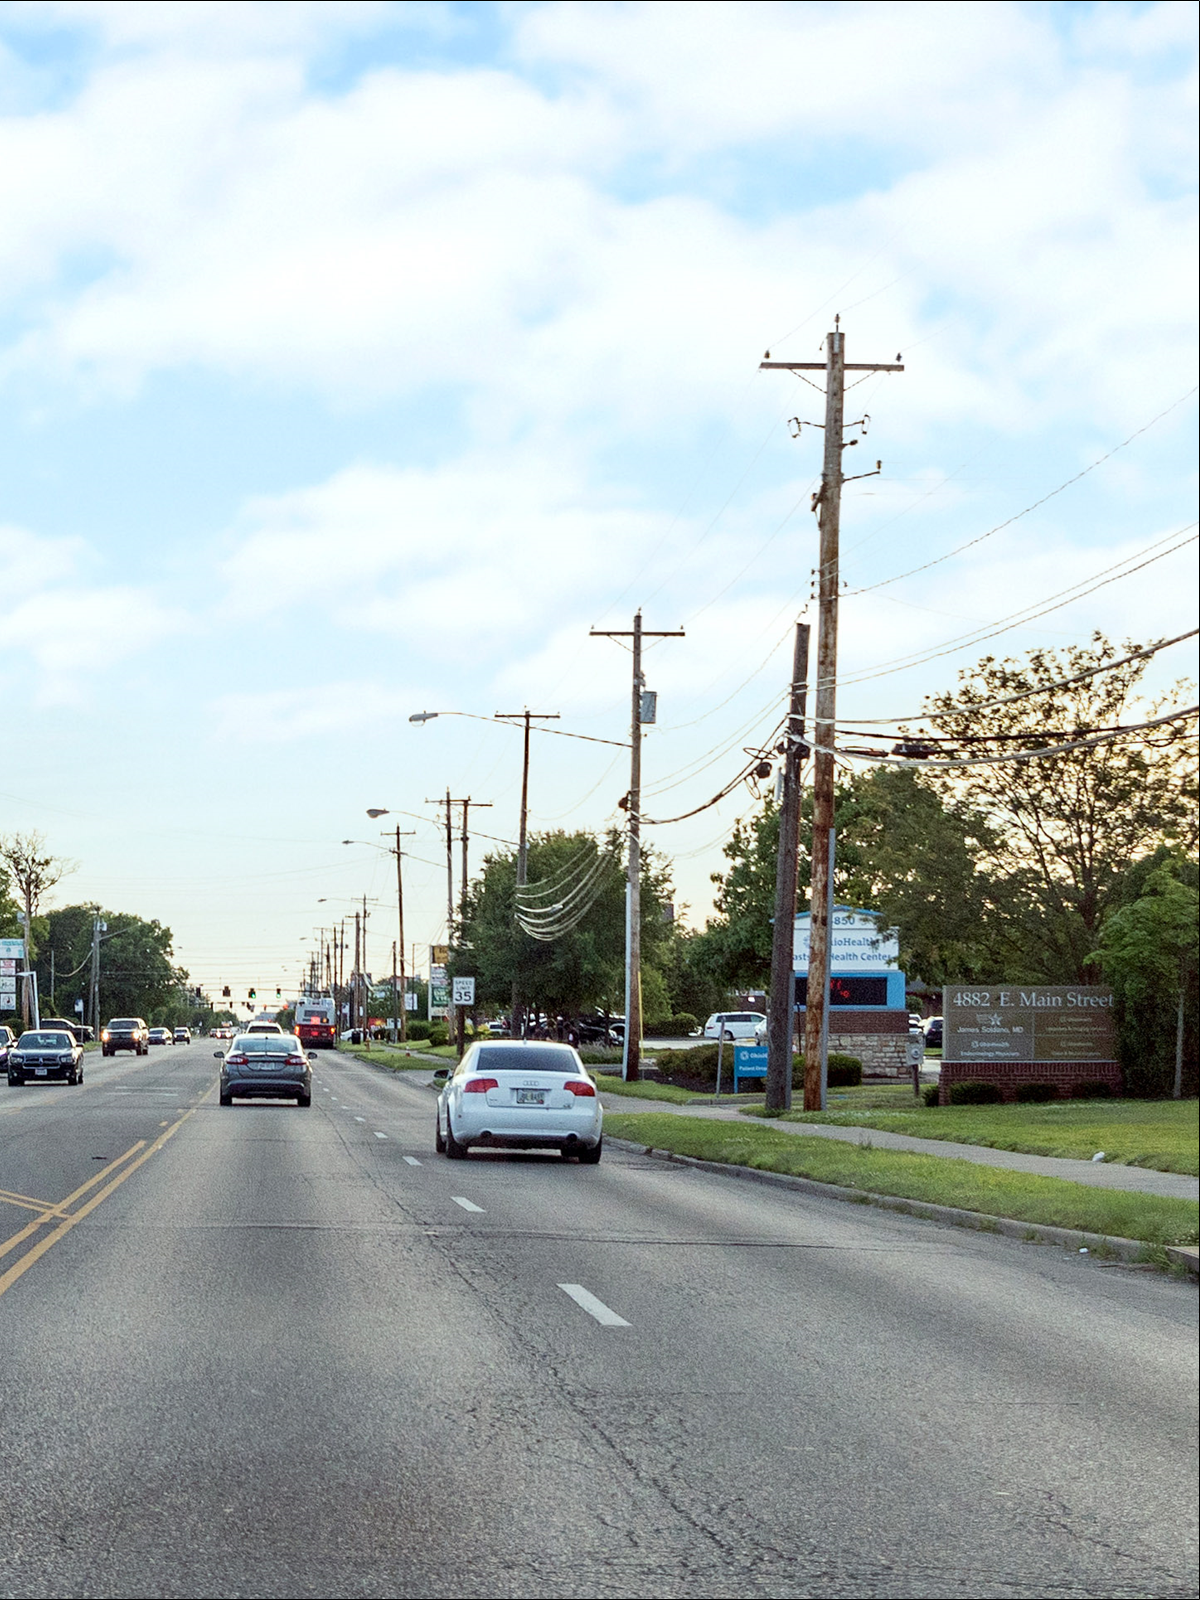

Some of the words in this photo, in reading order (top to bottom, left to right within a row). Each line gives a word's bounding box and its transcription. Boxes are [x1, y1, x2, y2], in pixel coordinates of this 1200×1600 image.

[832, 917, 855, 925] 850
[830, 937, 877, 946] ioHealt
[831, 953, 858, 961] Health
[860, 953, 891, 961] Center
[455, 991, 472, 1002] 35
[953, 992, 990, 1007] 4882
[1000, 992, 1014, 1007] E.
[1020, 992, 1062, 1007] Main
[1067, 992, 1114, 1007] Street
